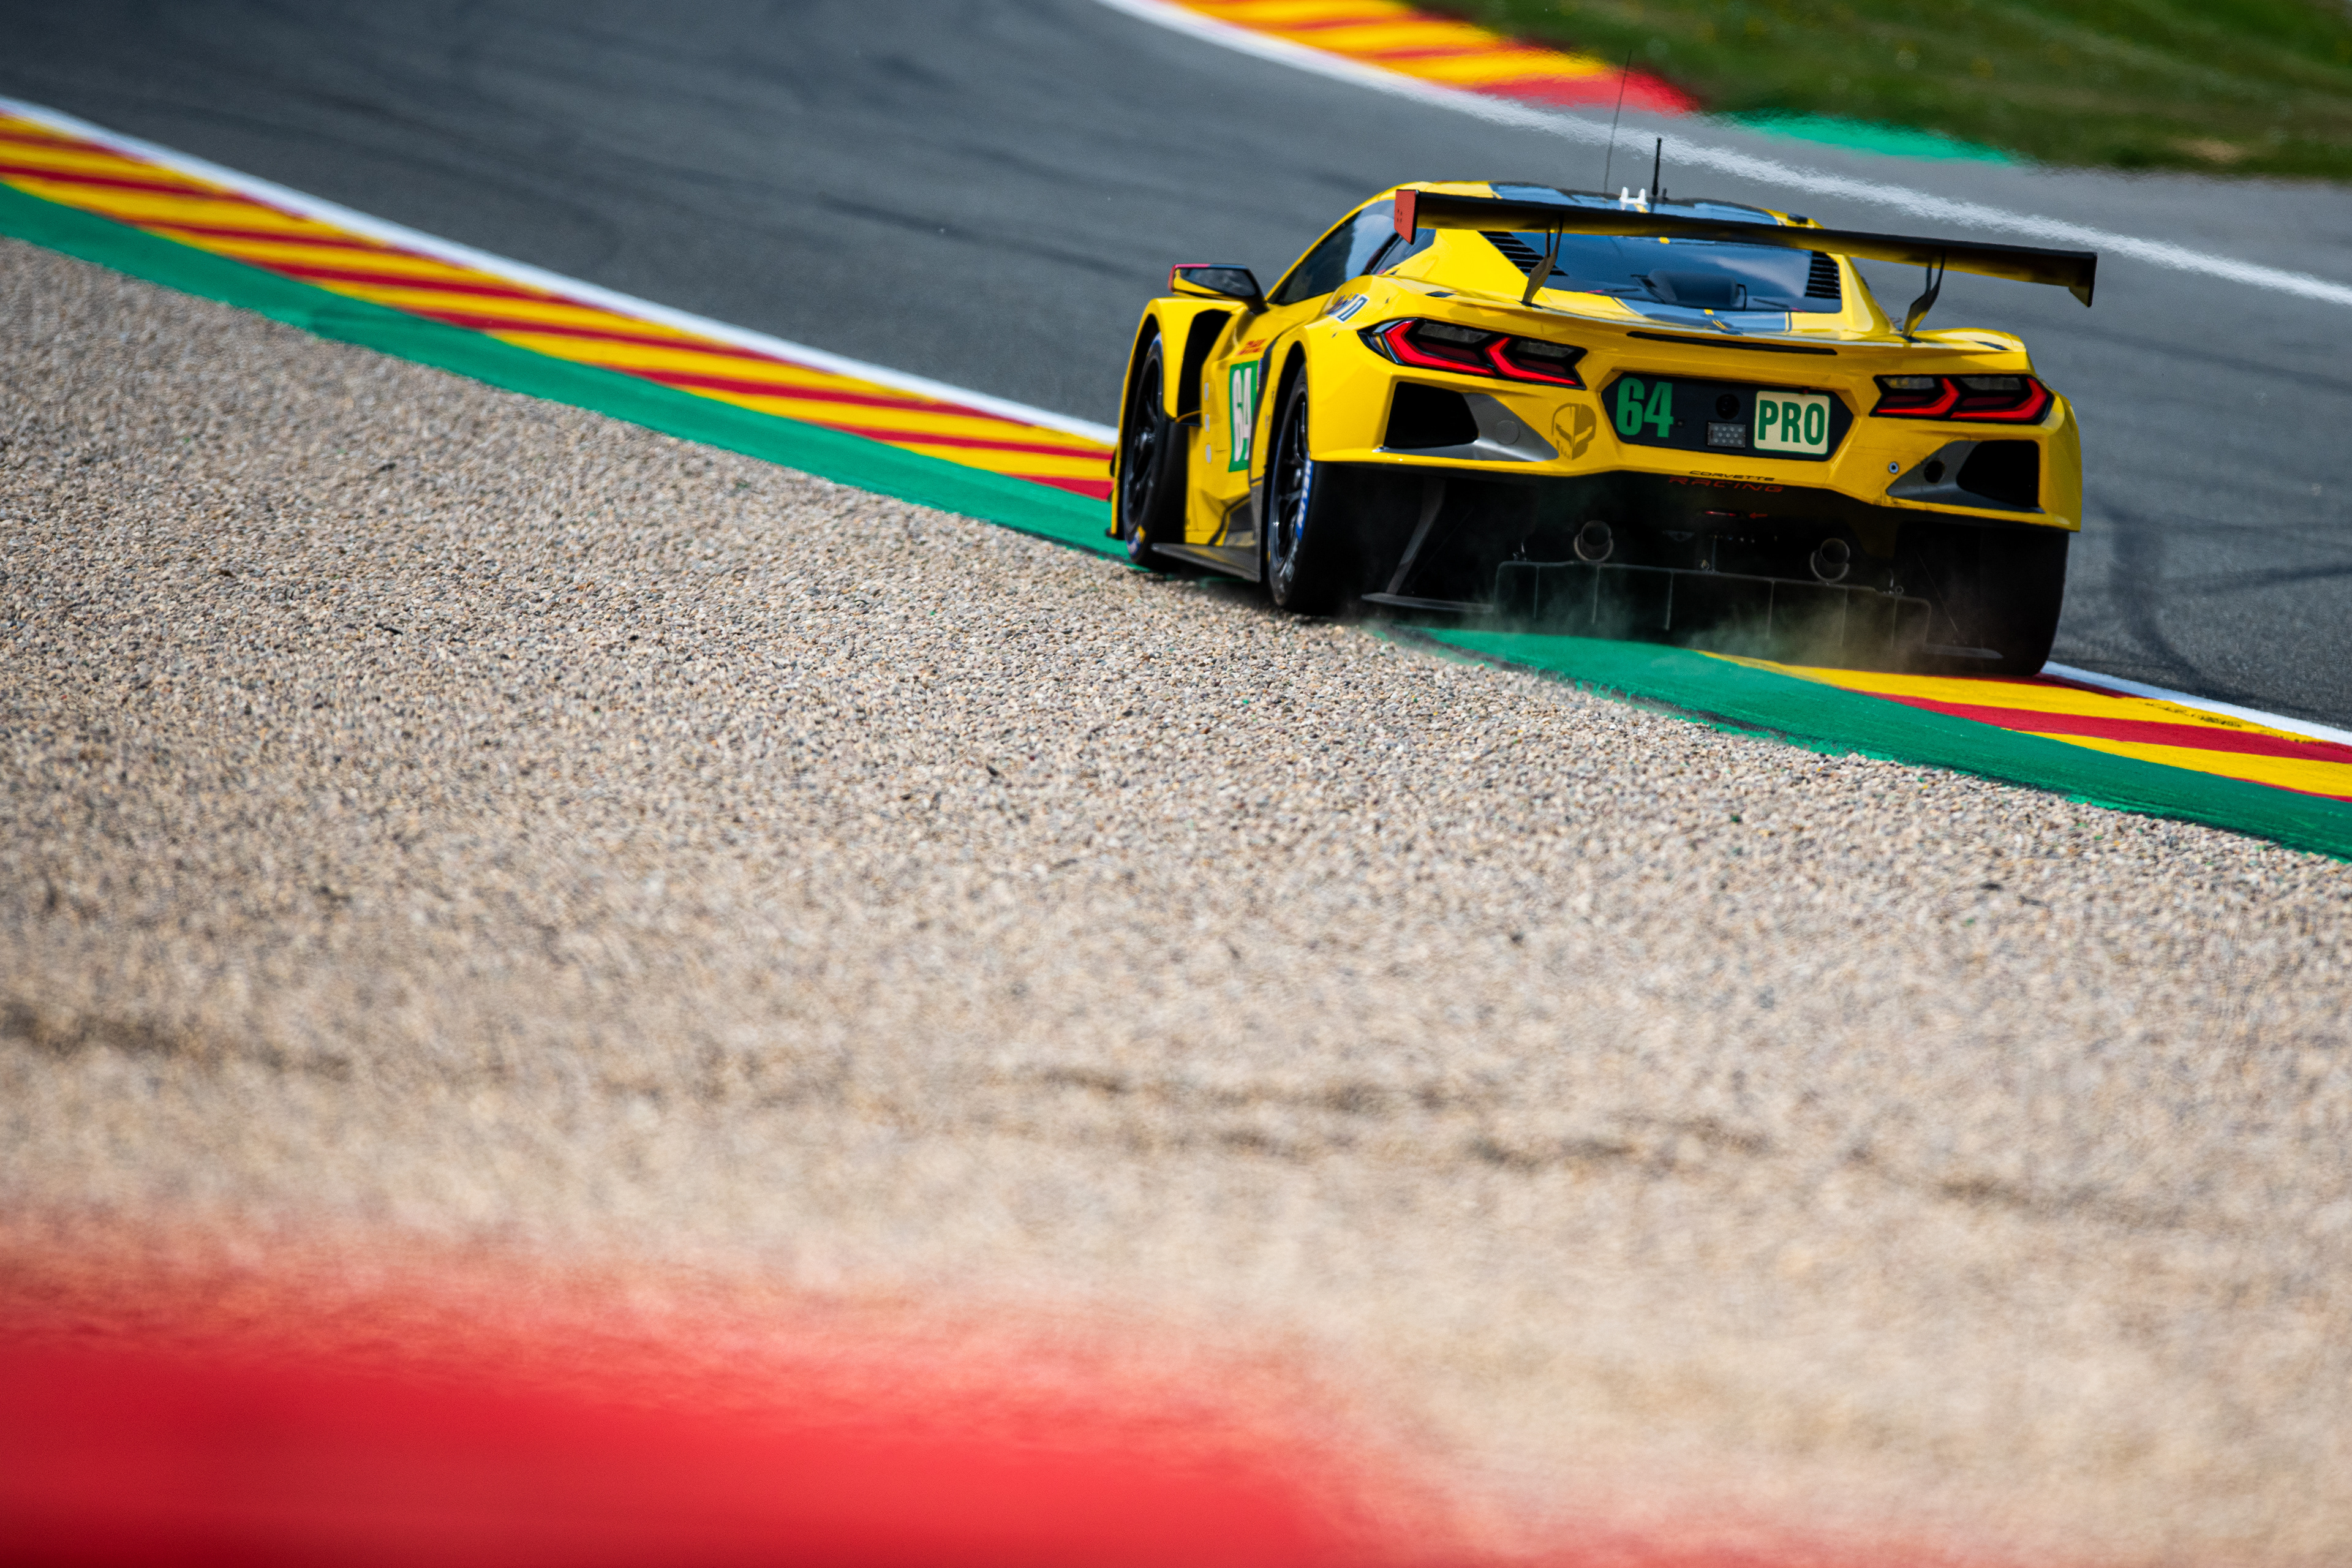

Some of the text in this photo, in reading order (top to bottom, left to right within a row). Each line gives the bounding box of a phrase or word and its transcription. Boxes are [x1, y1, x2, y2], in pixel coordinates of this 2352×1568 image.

[1232, 367, 1253, 462] 64
[1616, 377, 1674, 438] 64
[1757, 399, 1826, 446] PRO
[1668, 475, 1784, 493] RACING
[1689, 470, 1776, 482] CORVETTE
